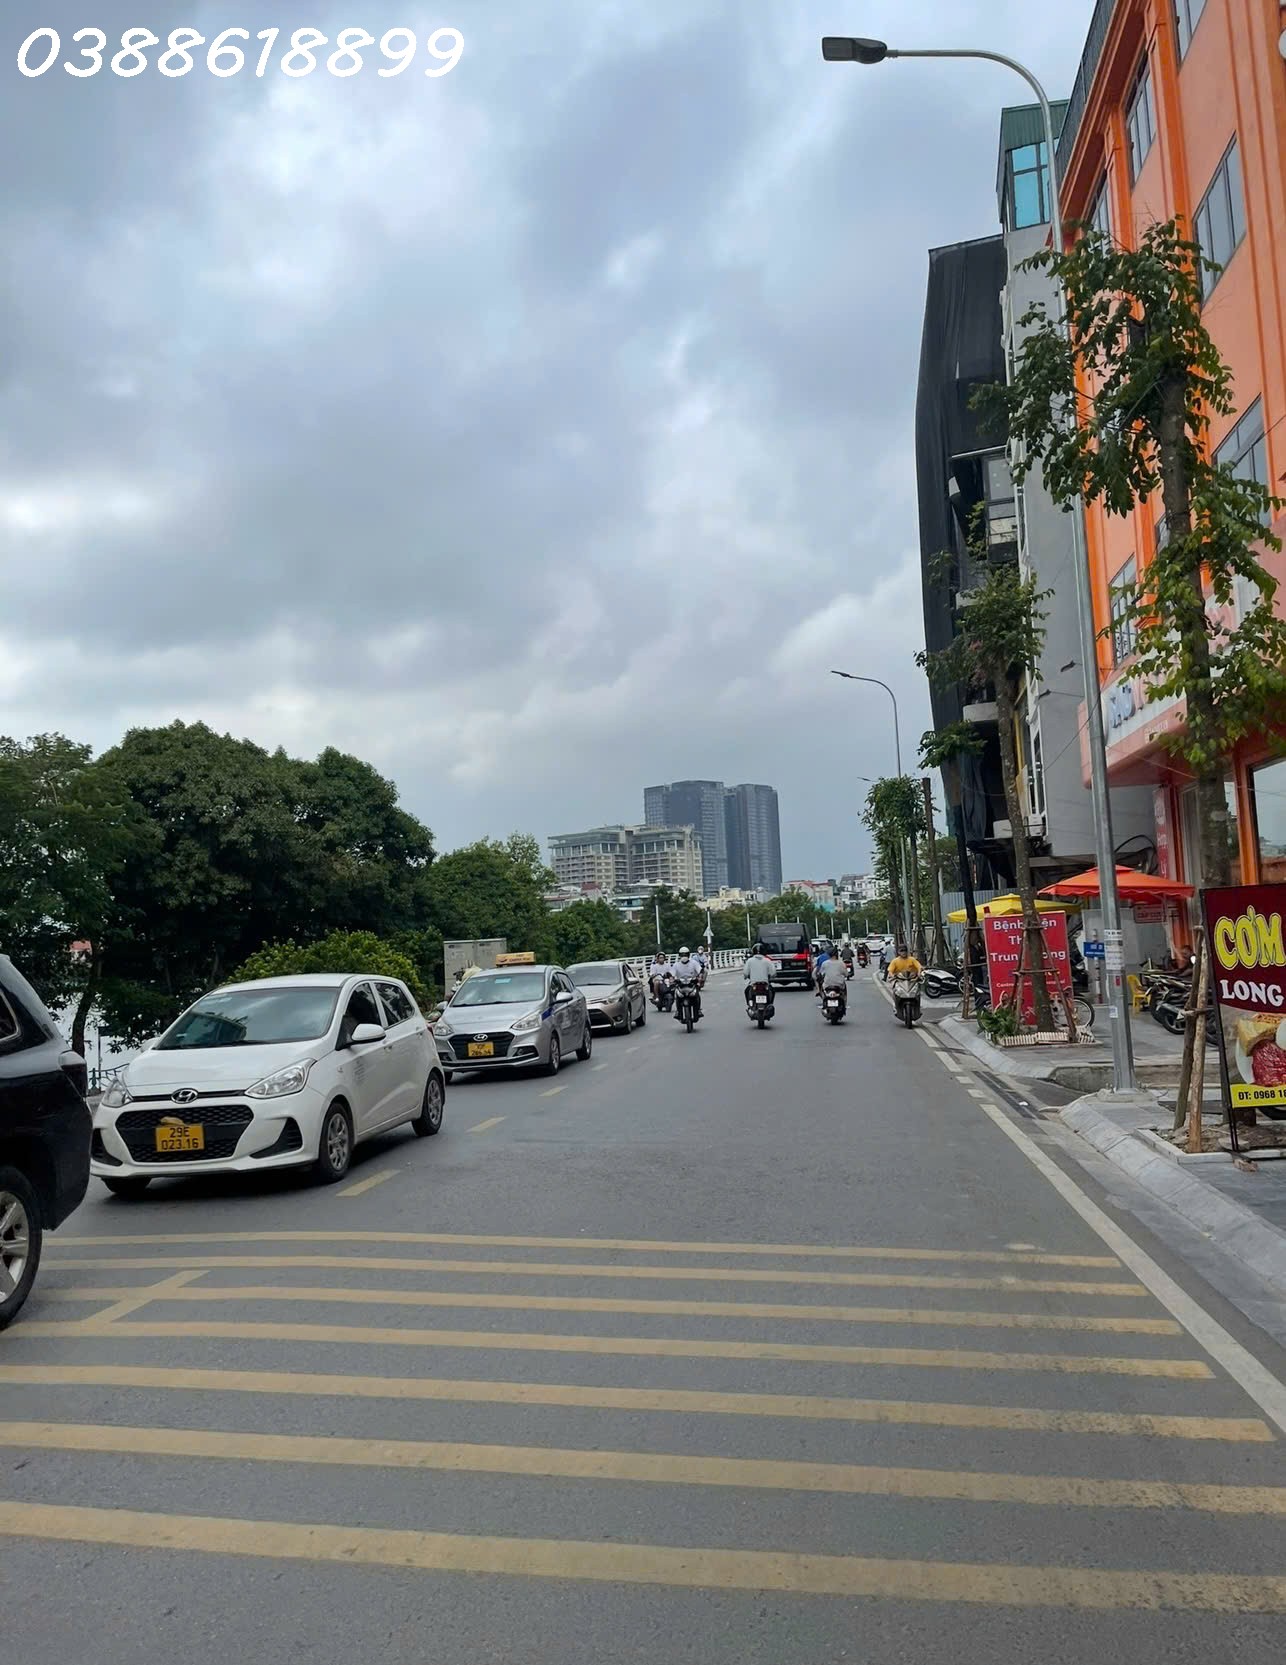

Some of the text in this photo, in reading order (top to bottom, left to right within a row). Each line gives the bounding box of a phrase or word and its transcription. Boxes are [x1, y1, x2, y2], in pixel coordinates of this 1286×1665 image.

[990, 952, 1018, 962] Trun
[1220, 979, 1284, 1007] LONG
[1253, 1089, 1276, 1099] 0968
[169, 1126, 190, 1138] 29E
[161, 1138, 199, 1150] 023.16
